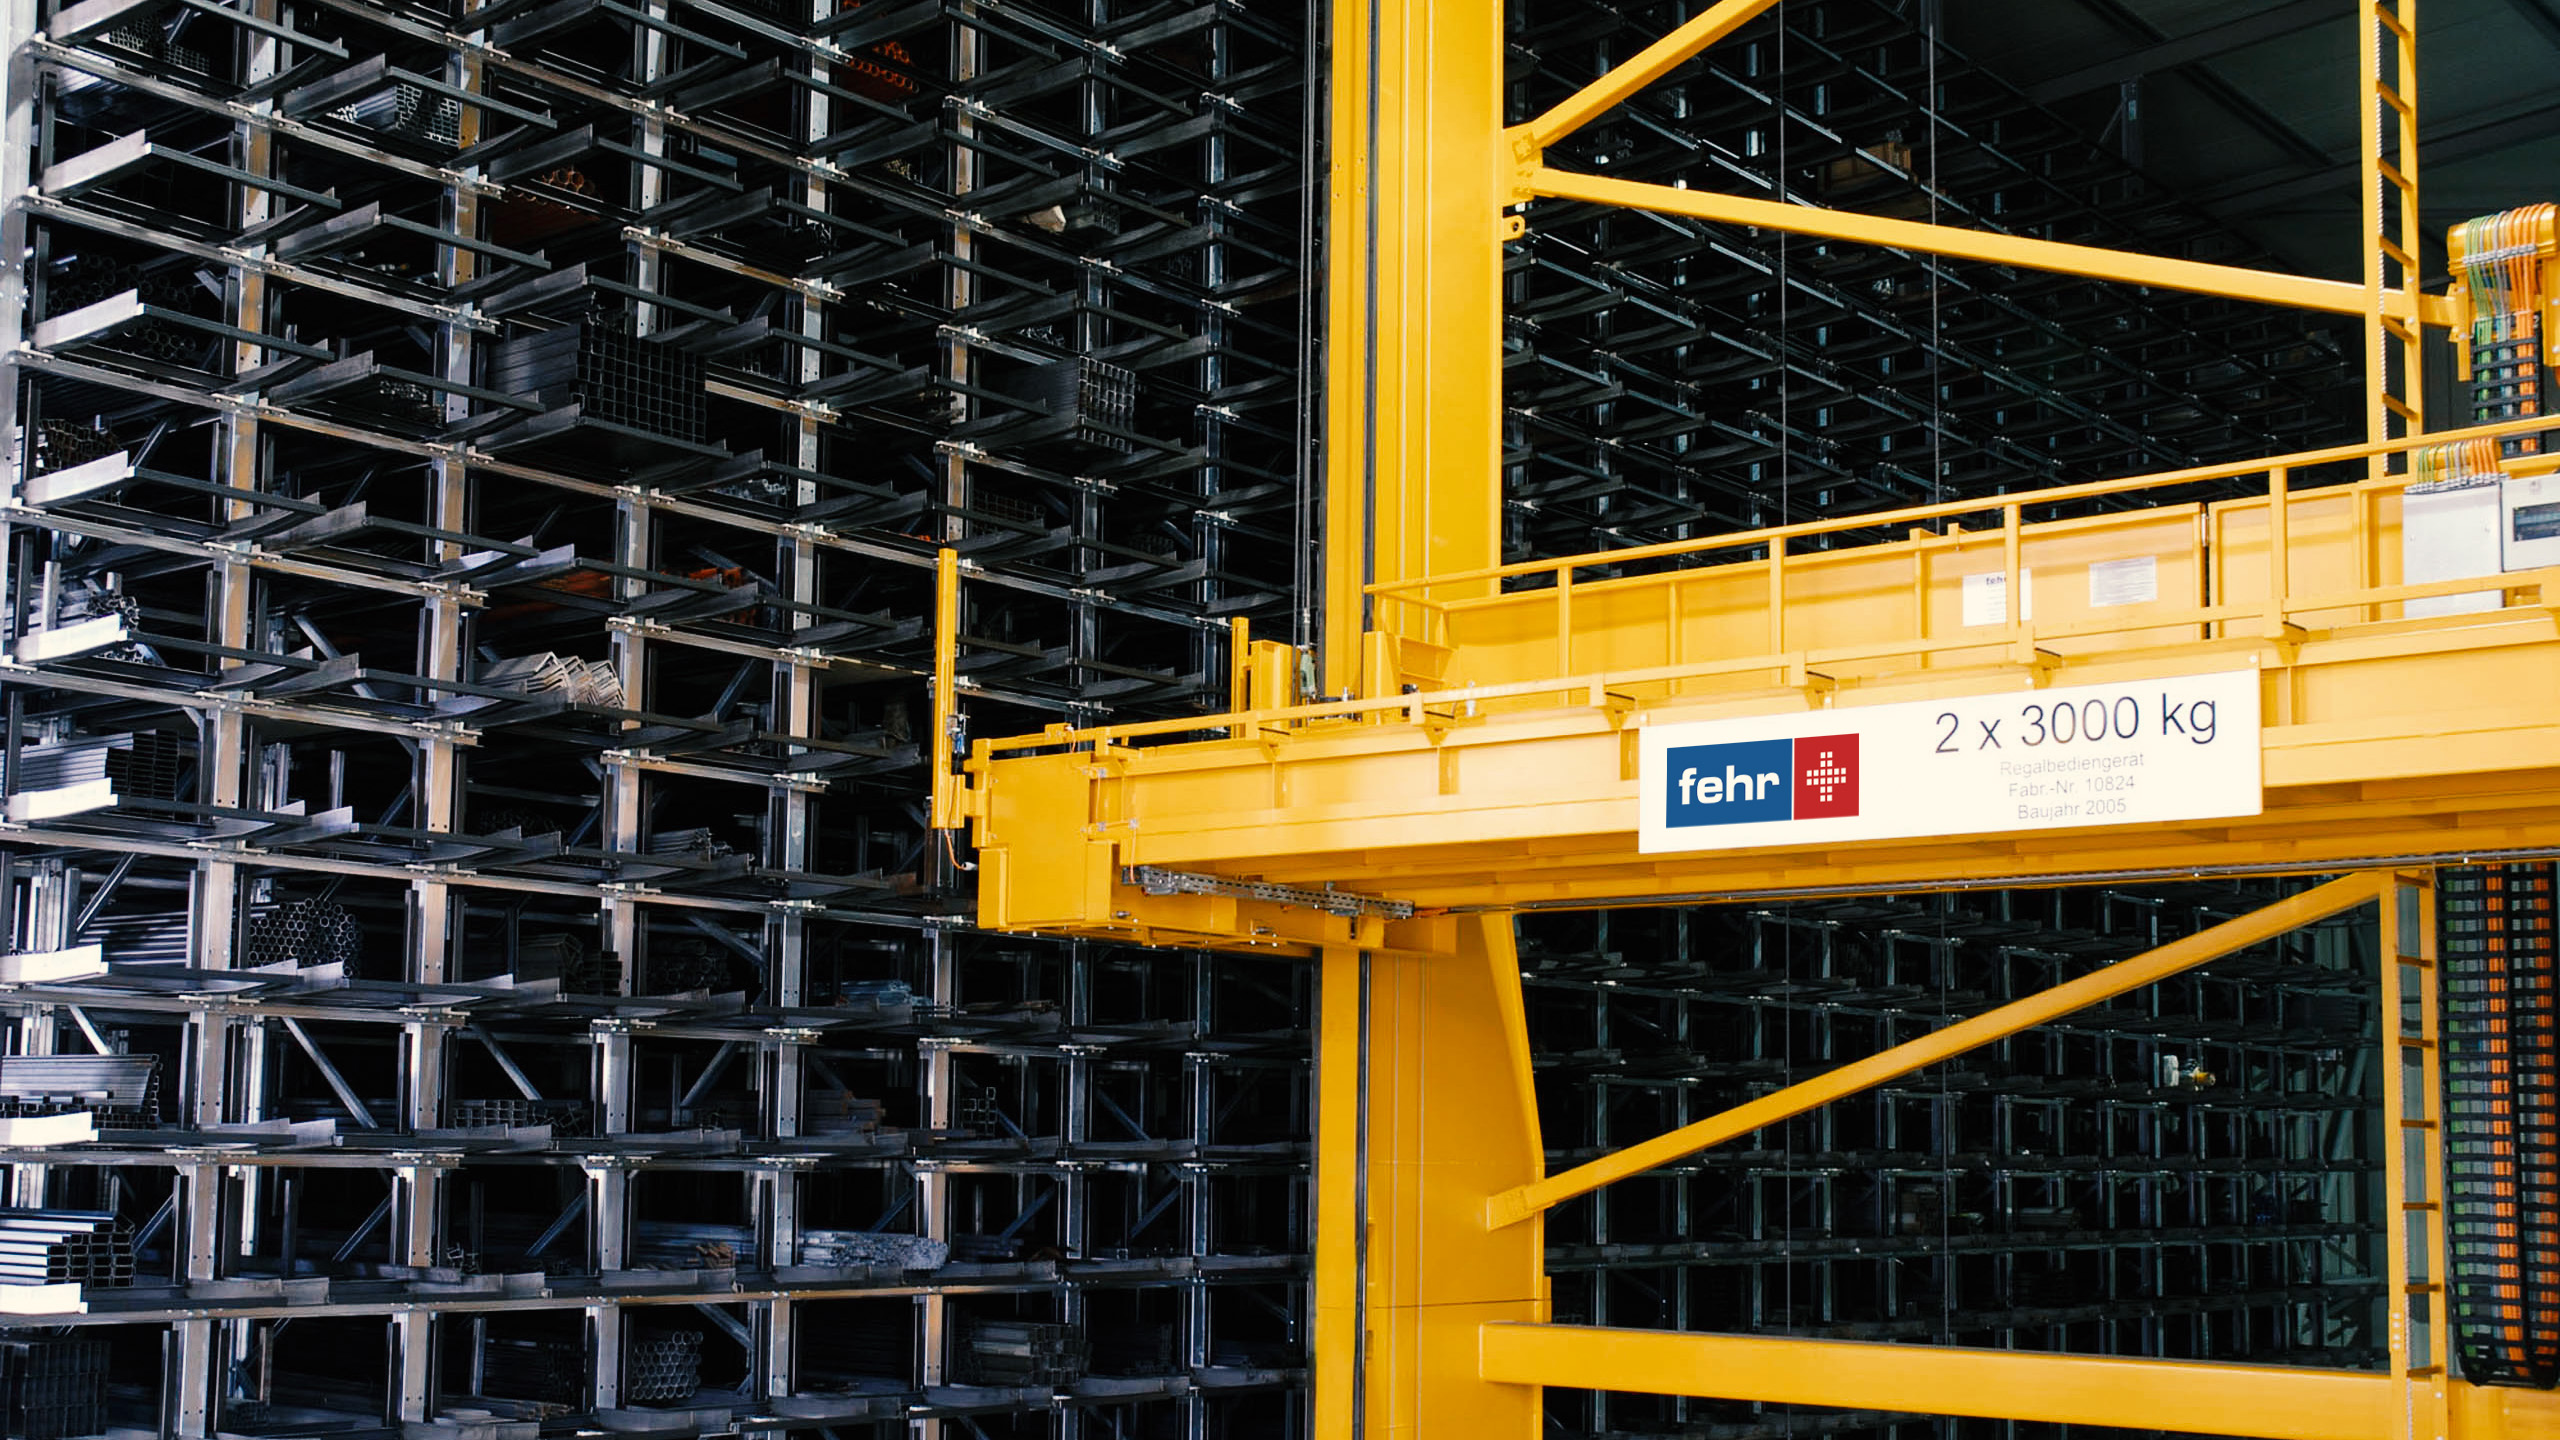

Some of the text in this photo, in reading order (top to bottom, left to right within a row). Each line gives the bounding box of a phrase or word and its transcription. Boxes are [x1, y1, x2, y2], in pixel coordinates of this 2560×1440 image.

[1935, 693, 2216, 753] 2 x 3000 kg
[1678, 765, 1780, 805] fehr
[2086, 775, 2136, 792] 10824
[2018, 797, 2127, 821] Baujahr 2005
